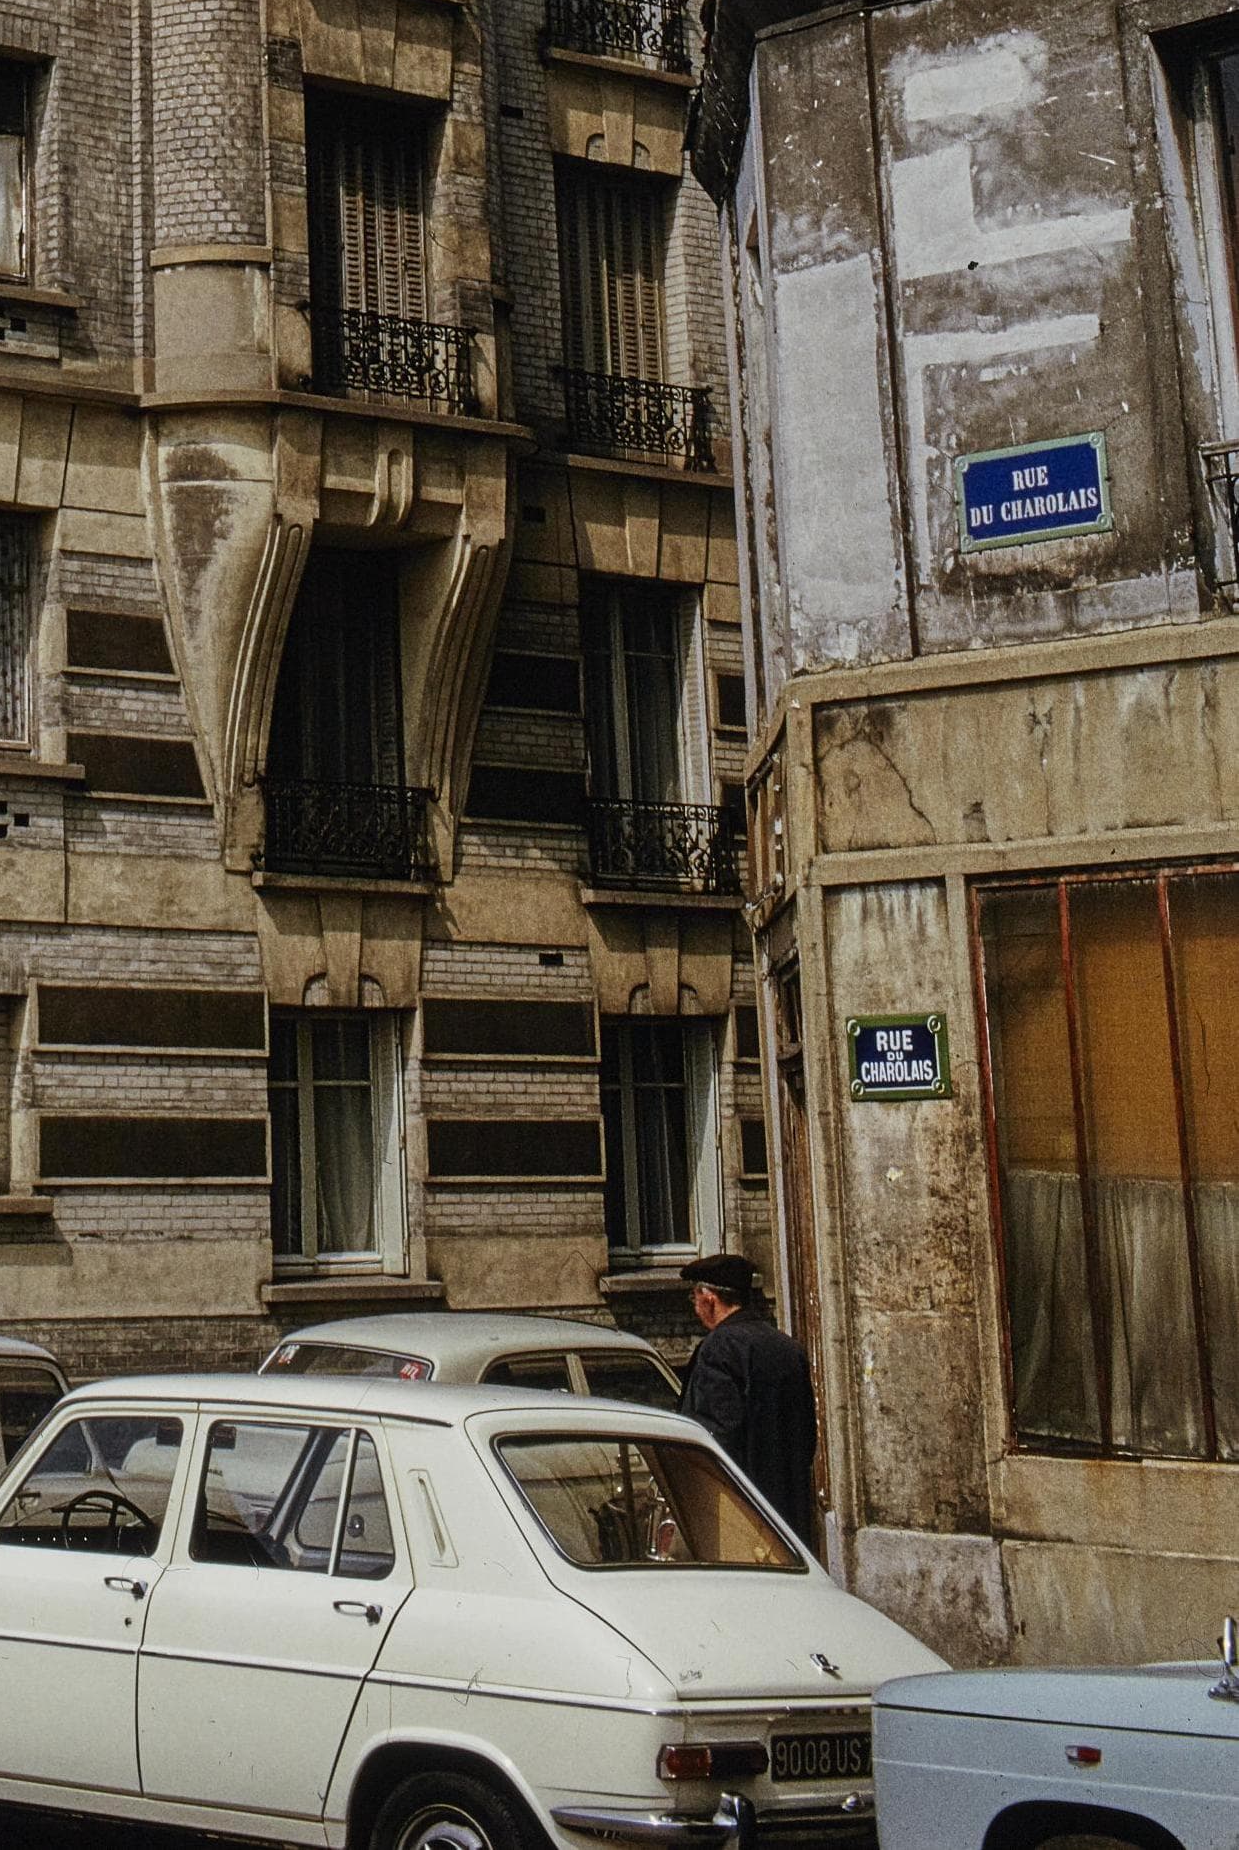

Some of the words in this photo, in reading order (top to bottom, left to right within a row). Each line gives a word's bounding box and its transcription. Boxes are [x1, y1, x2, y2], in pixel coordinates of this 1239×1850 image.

[1012, 466, 1048, 491] RUE
[970, 505, 993, 527] DU
[1001, 487, 1098, 521] CHAROLAIS
[876, 1030, 913, 1052] RUE
[887, 1051, 904, 1061] DU
[861, 1059, 933, 1083] CHAROLAIS
